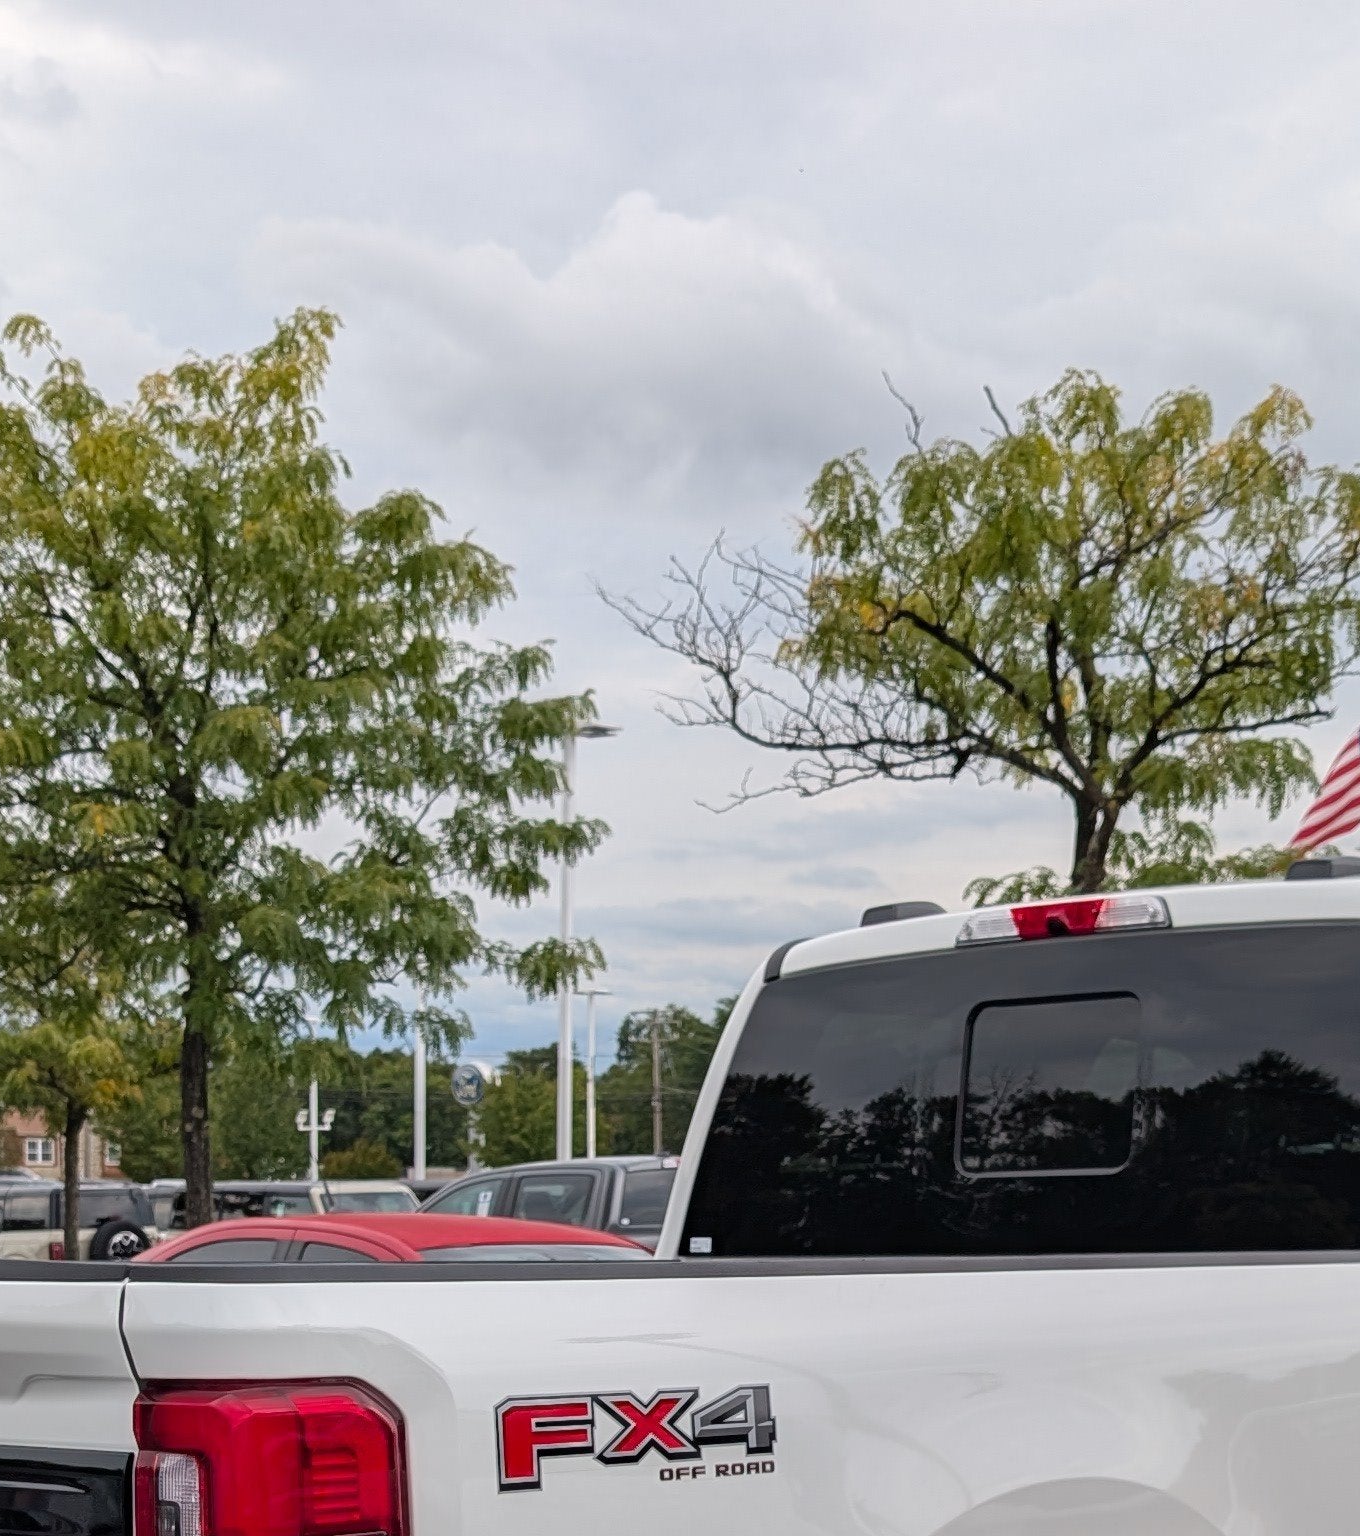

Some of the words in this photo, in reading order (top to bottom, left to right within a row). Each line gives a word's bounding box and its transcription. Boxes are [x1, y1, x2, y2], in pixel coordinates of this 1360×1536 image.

[493, 1382, 777, 1494] FX4
[659, 1465, 707, 1482] OFF
[714, 1460, 775, 1478] ROAD
